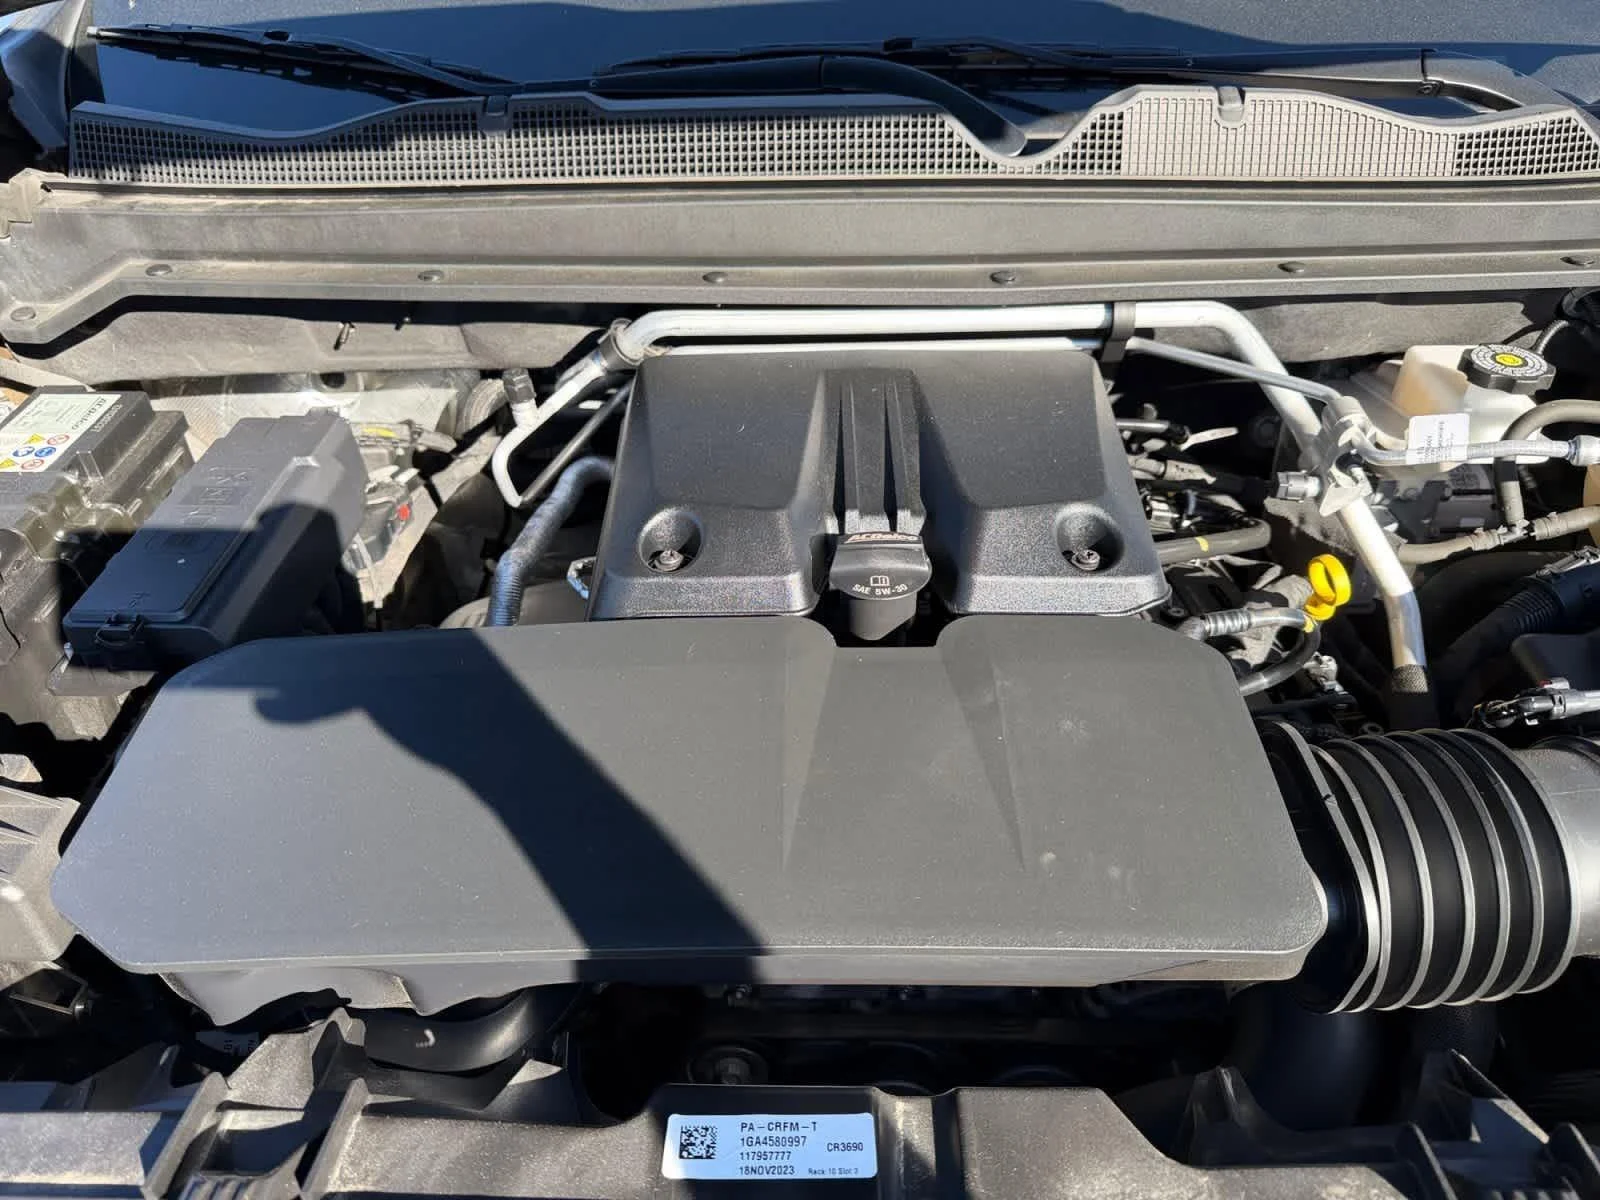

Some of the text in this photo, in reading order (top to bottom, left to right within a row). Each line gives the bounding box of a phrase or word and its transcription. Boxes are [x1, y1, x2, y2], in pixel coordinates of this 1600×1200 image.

[852, 584, 909, 595] SAE 5W-30
[740, 1136, 807, 1147] 1GA4580997
[826, 1142, 864, 1152] CR3690
[740, 1151, 791, 1161] 117957777
[739, 1165, 796, 1176] 18NOV2023
